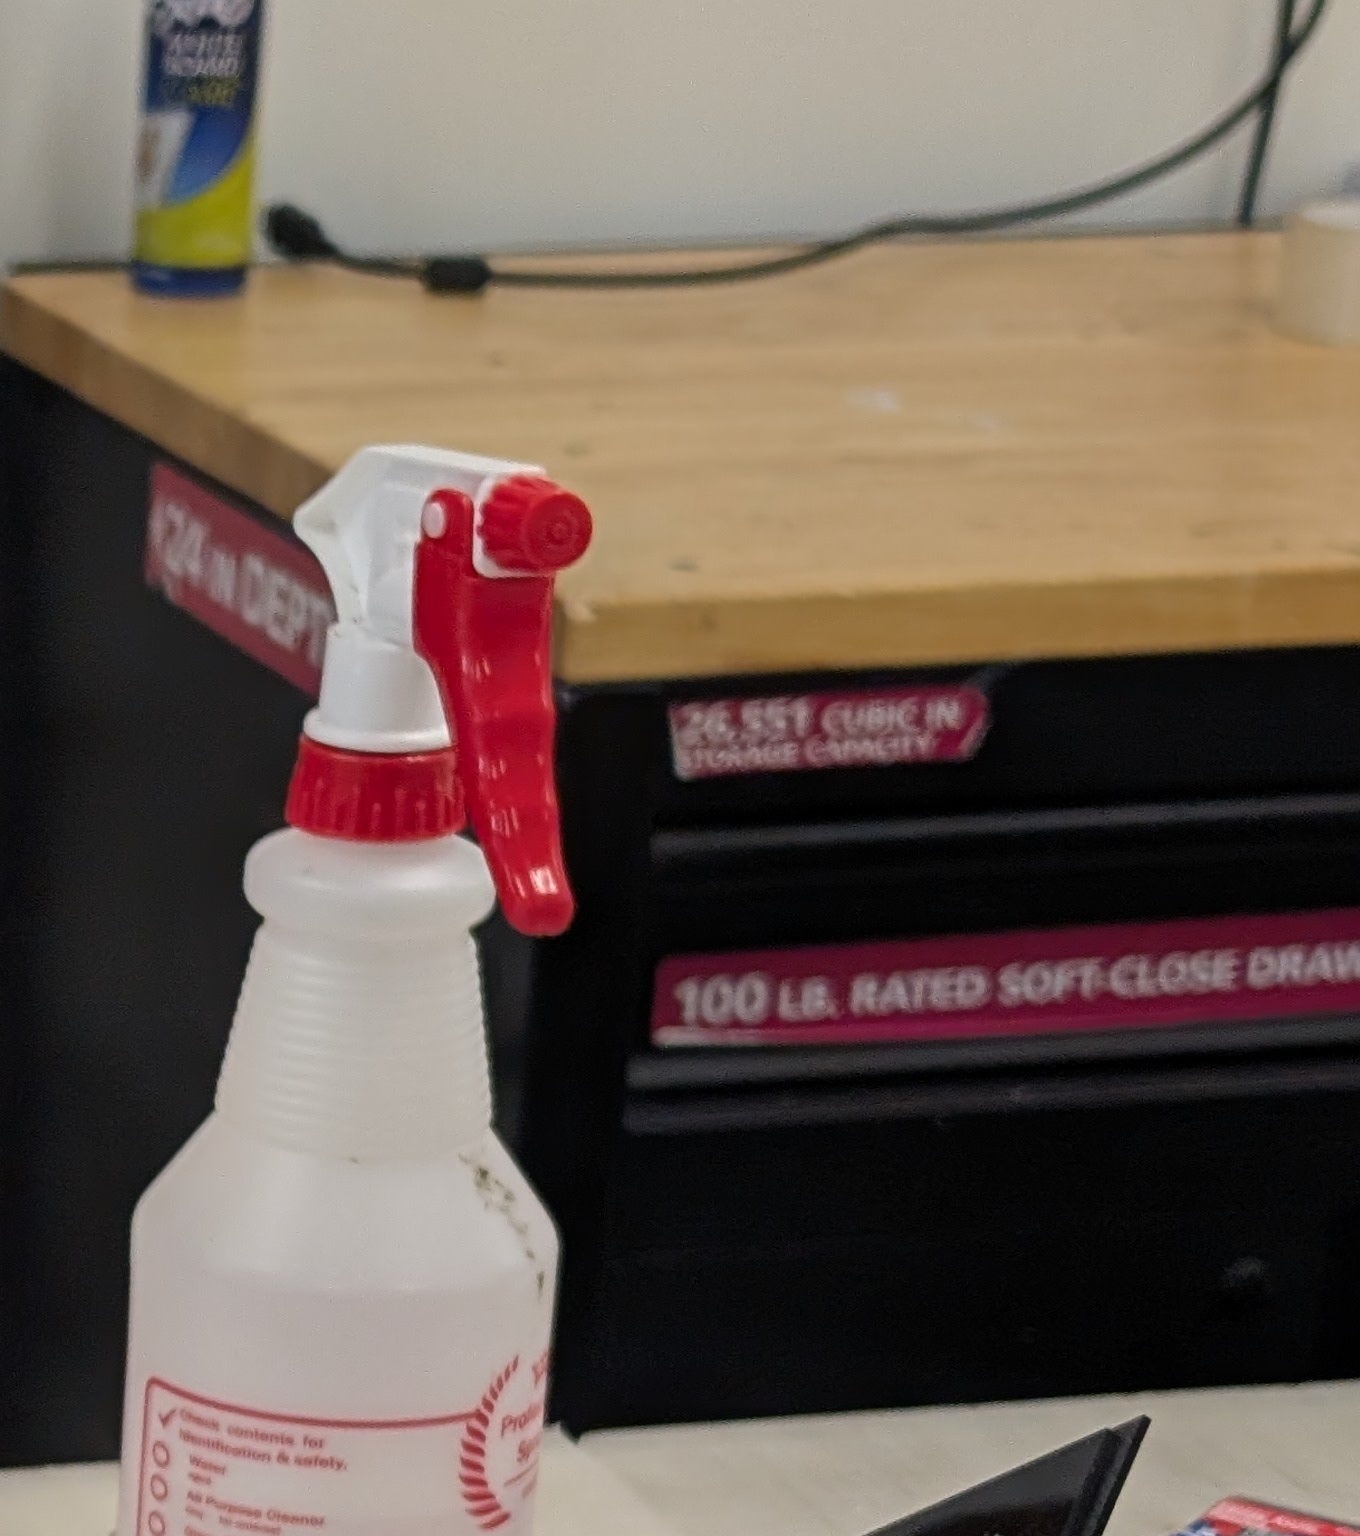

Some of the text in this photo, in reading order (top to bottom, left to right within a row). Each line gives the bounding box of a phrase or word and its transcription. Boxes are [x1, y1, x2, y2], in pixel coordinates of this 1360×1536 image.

[239, 552, 331, 668] DEPT
[821, 698, 920, 734] CUBIC
[926, 697, 961, 728] IN
[675, 972, 770, 1025] 100
[778, 976, 839, 1022] LB.
[849, 966, 989, 1017] RATED
[998, 950, 1240, 1008] SOFT-CLOSE
[227, 1424, 296, 1447] contents
[302, 1434, 326, 1449] for
